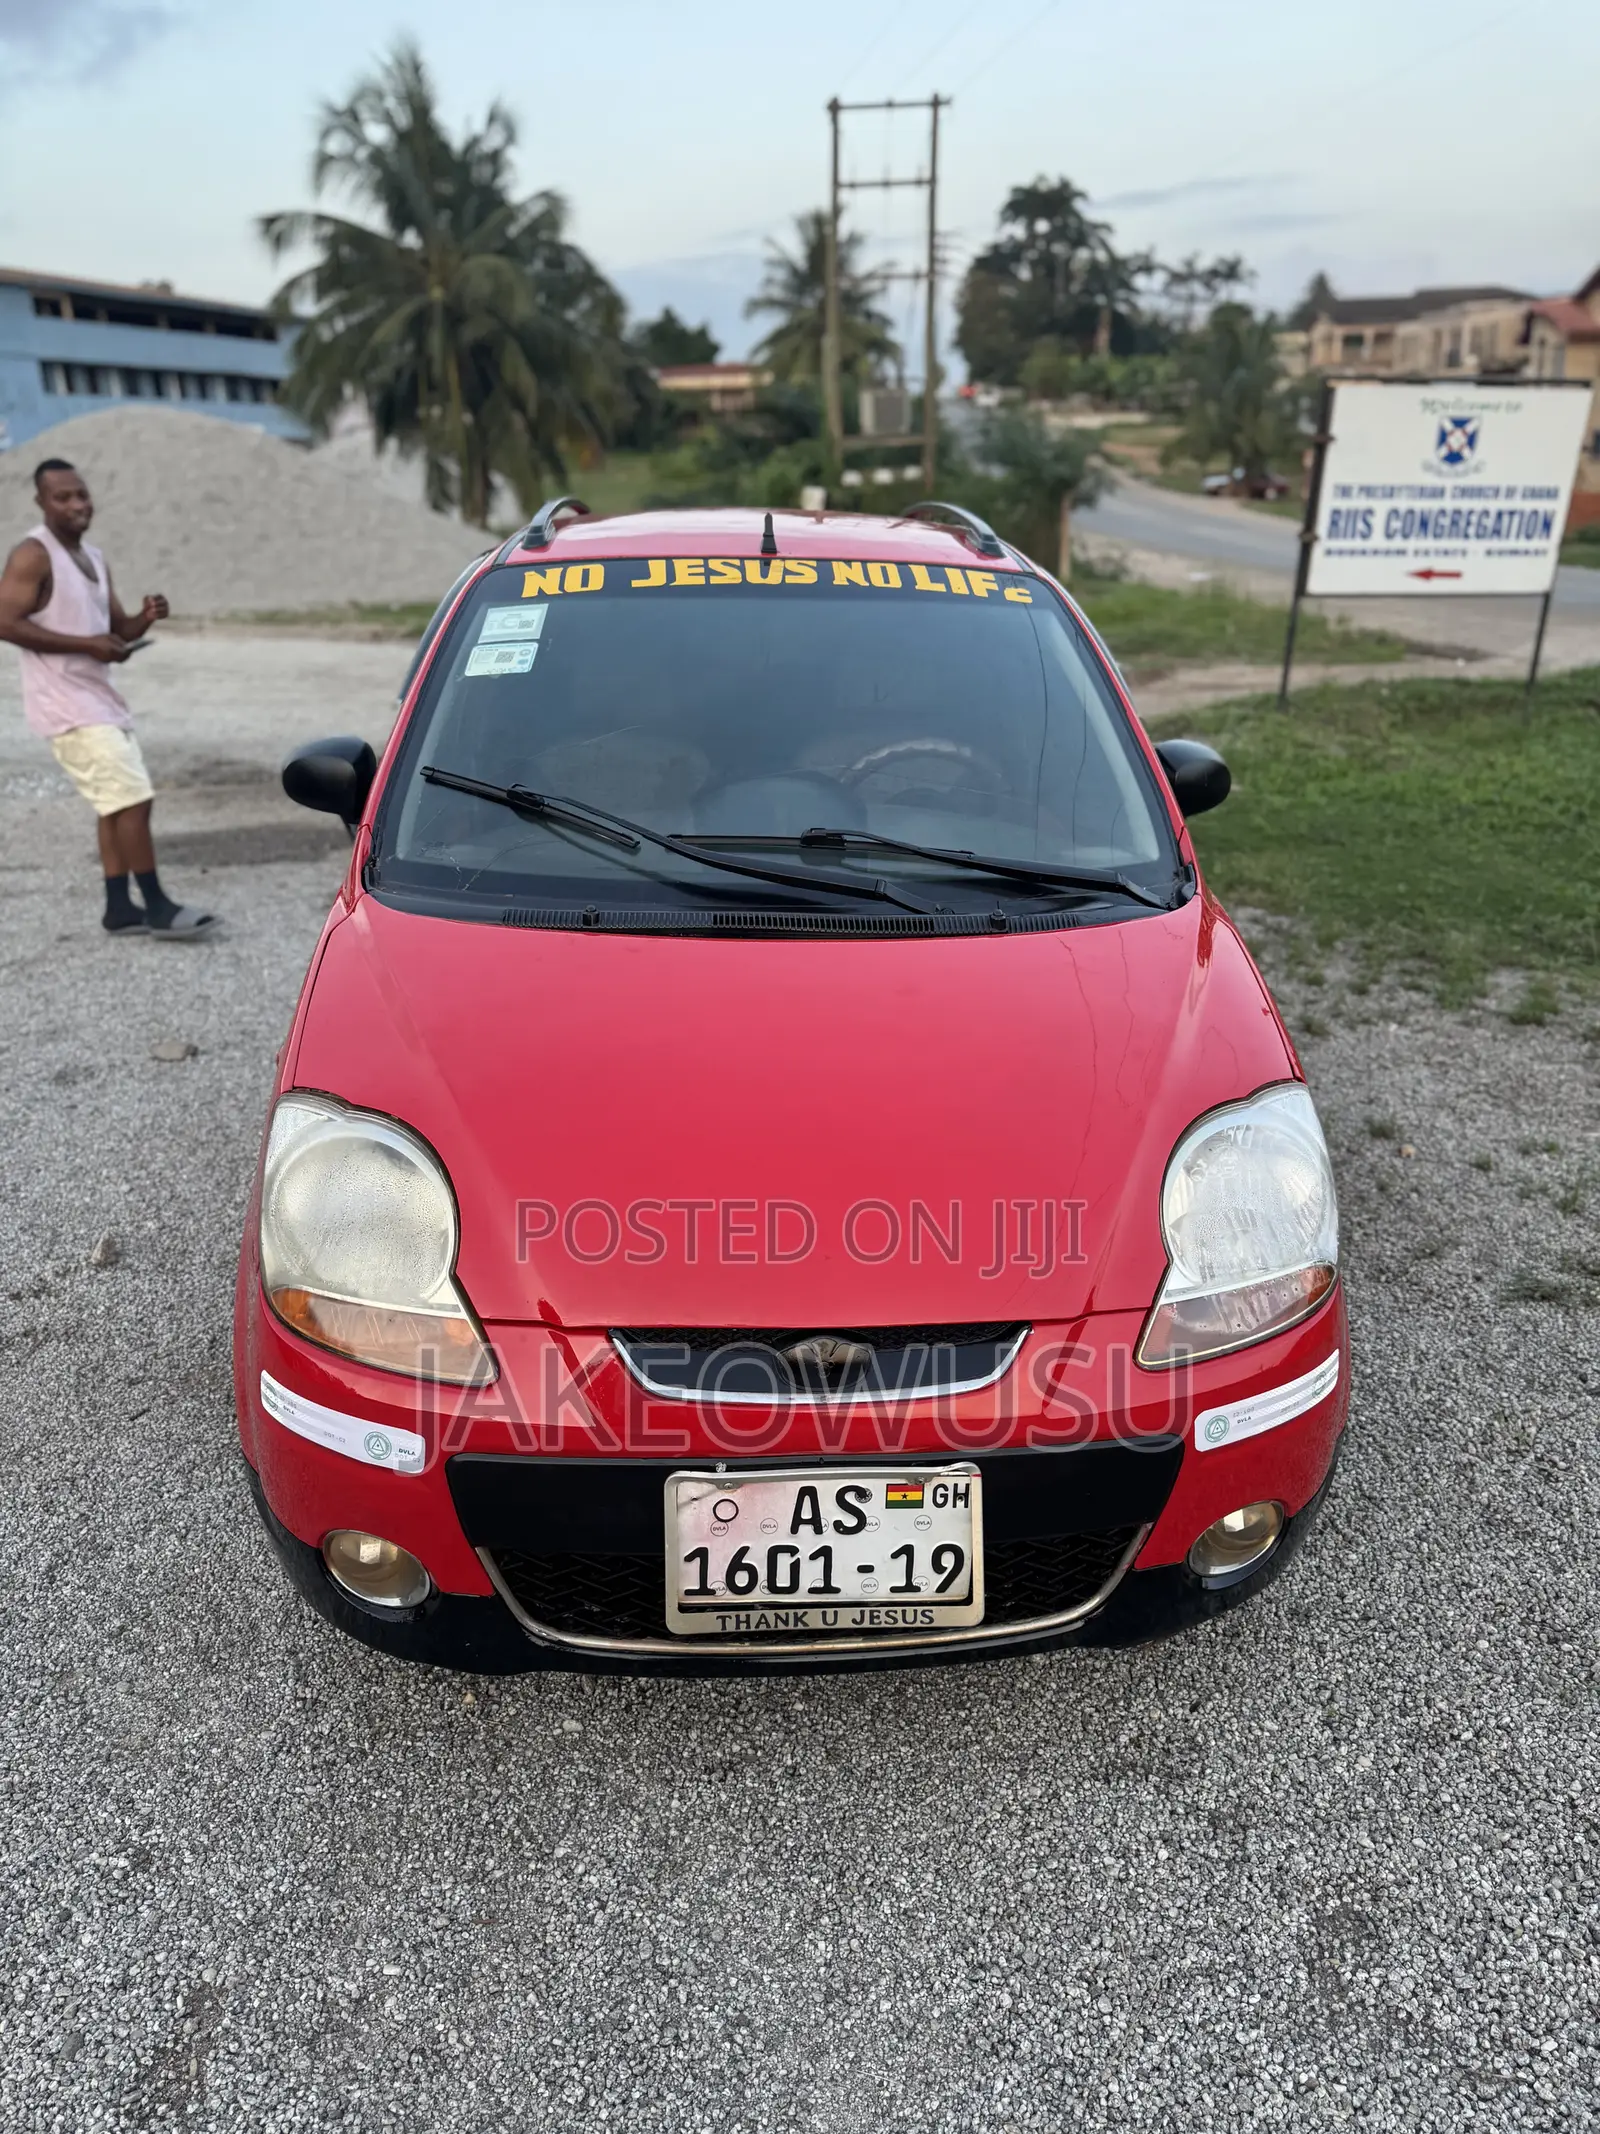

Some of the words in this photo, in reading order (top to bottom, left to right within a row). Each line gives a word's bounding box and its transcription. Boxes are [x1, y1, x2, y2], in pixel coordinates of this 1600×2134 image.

[1333, 484, 1353, 499] THE
[1358, 484, 1445, 499] PRESBYTERIAN
[1451, 484, 1499, 499] CHURCH
[1504, 484, 1518, 499] OF
[1521, 484, 1560, 499] GHANA
[1328, 507, 1375, 540] RIIS
[1384, 507, 1556, 541] CONGREGATION
[520, 564, 605, 598] NO
[631, 559, 820, 588] JESUS
[832, 561, 902, 589] NO
[1236, 1415, 1252, 1424] DVLA
[398, 1448, 416, 1456] DVLA
[790, 1485, 868, 1536] AS
[932, 1482, 970, 1509] GH
[715, 1610, 810, 1631] THANK
[821, 1610, 840, 1627] U
[851, 1608, 935, 1626] JESUS
